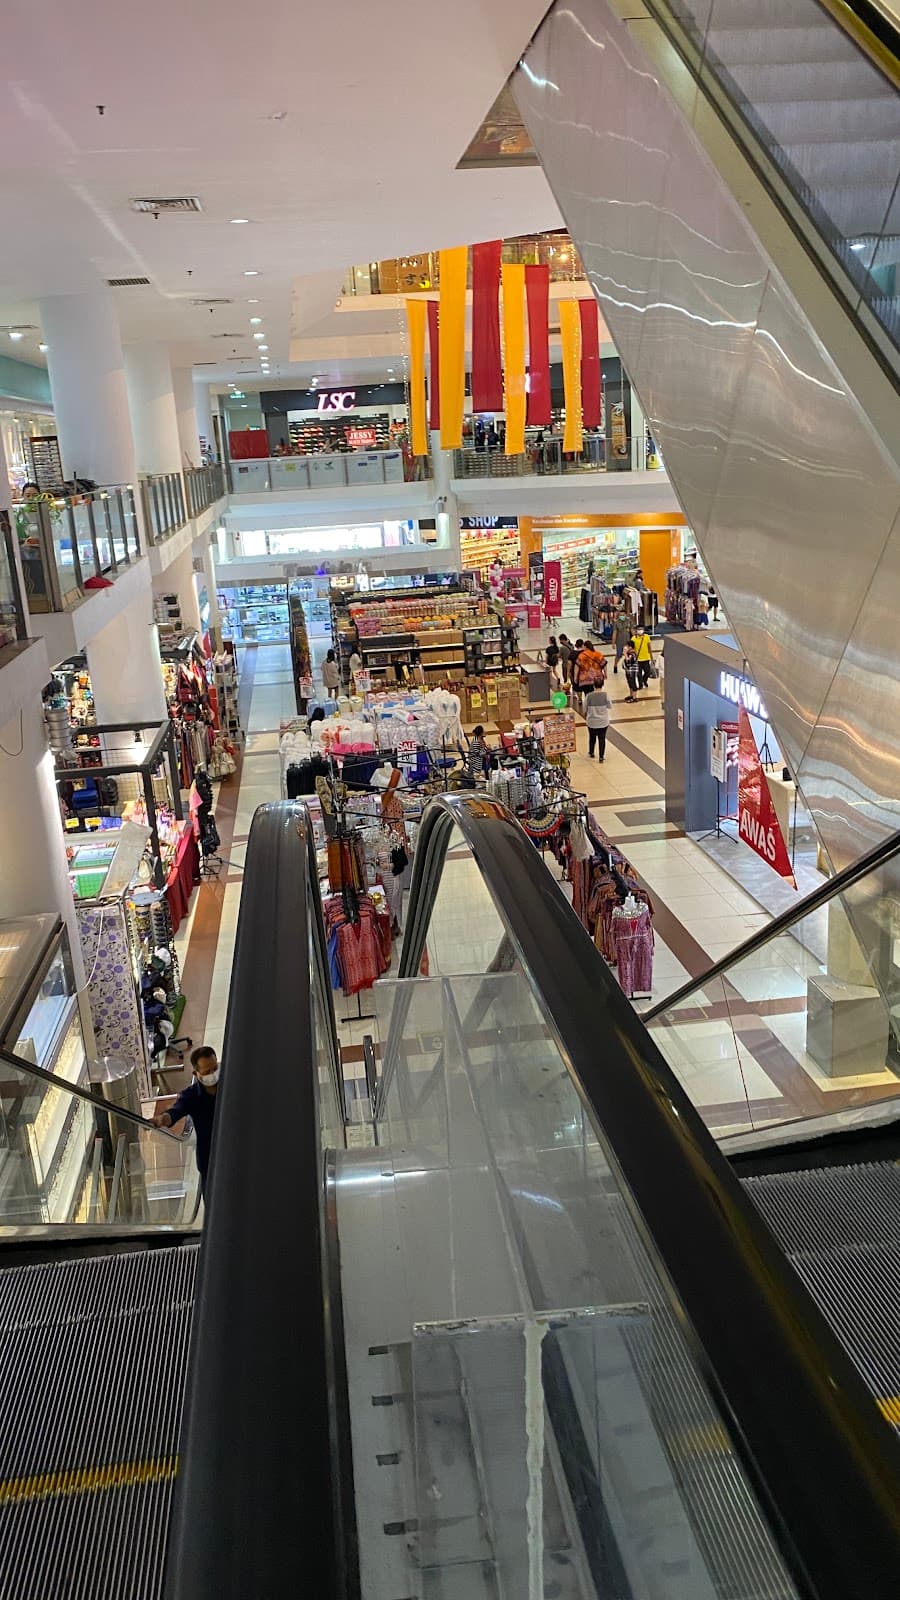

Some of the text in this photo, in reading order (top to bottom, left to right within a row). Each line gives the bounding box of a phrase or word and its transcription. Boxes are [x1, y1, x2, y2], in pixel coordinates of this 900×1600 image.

[317, 391, 356, 412] LSC
[350, 431, 373, 440] JESSY
[468, 515, 499, 528] SHOP
[549, 577, 558, 602] astro
[398, 741, 417, 750] SALE
[740, 807, 776, 862] AWAS
